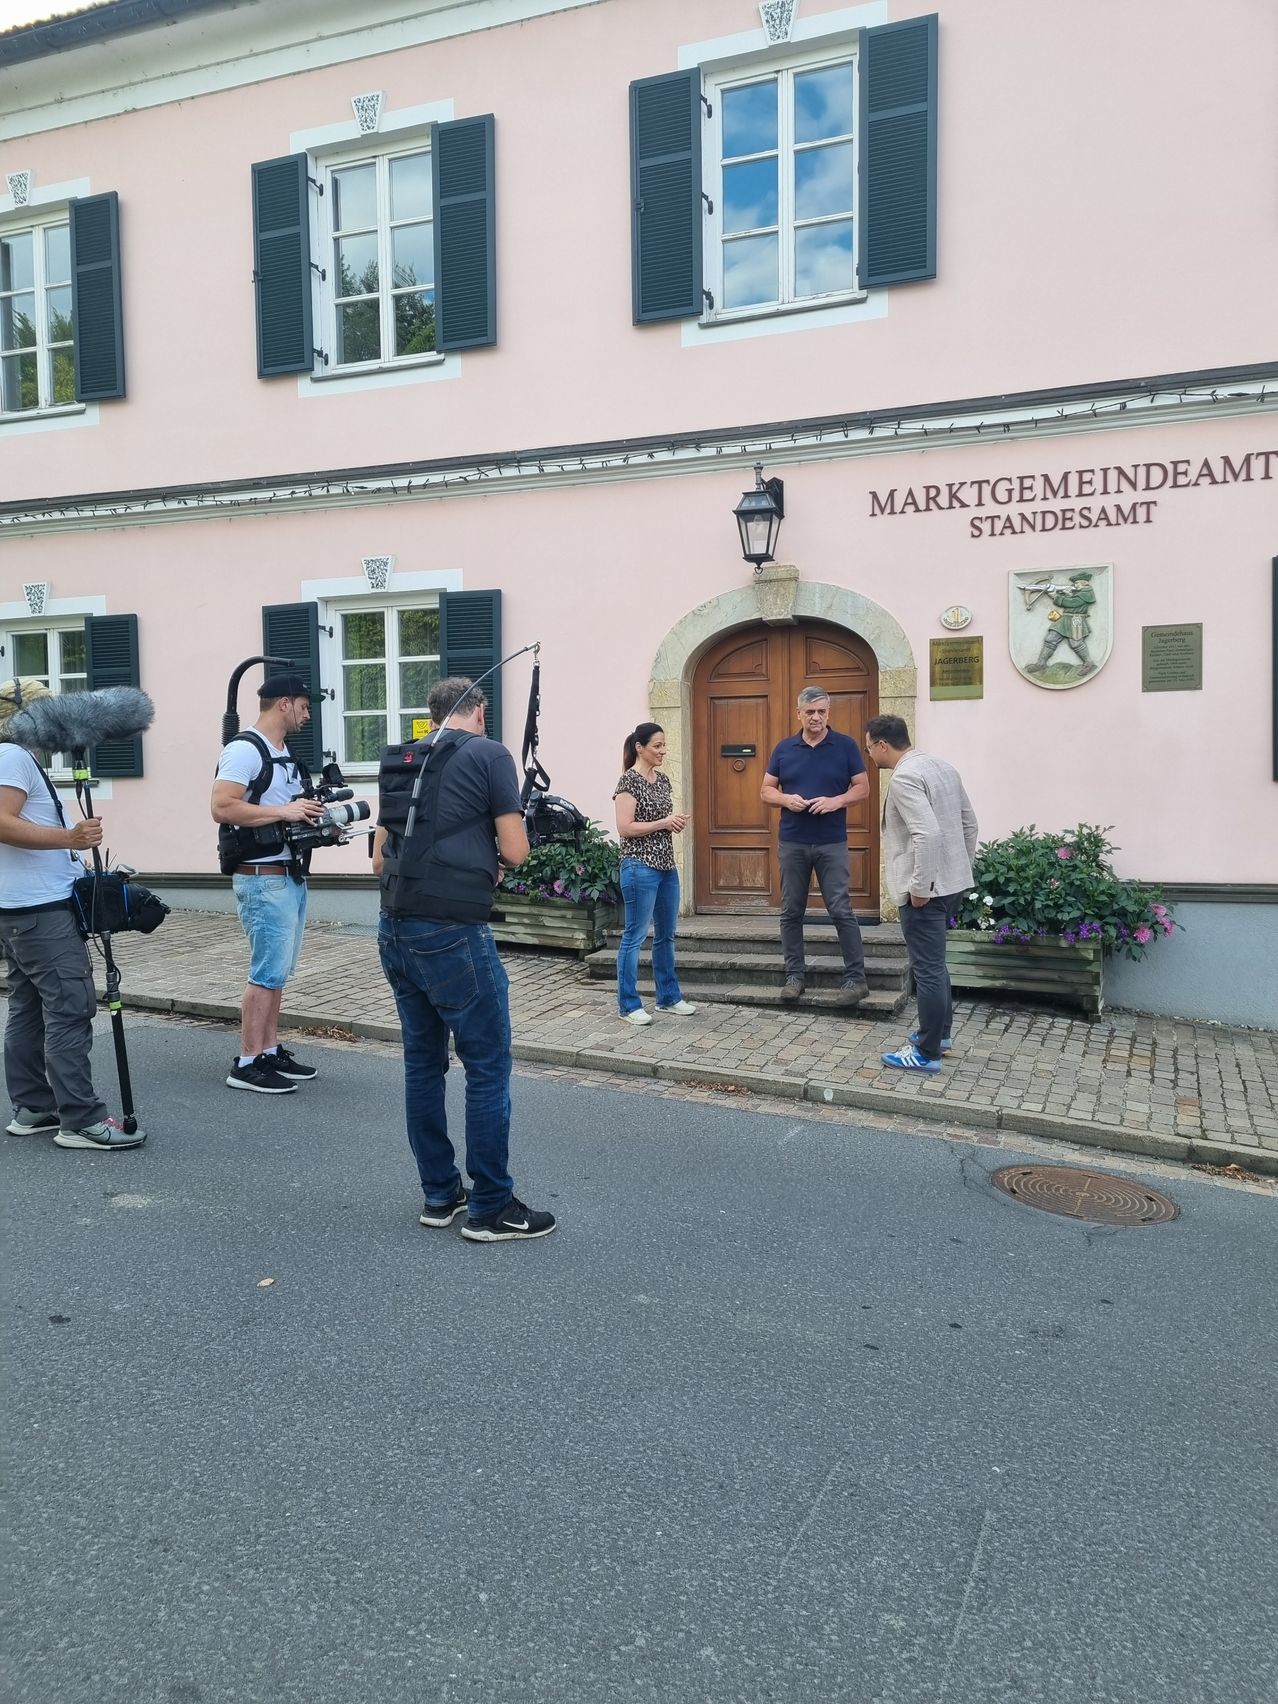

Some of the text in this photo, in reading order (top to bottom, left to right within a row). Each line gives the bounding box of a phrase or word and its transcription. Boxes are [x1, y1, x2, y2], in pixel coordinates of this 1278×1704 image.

[869, 450, 1278, 517] MARKTGEMEINDEAMT
[969, 500, 1158, 539] STANDESAMT
[952, 607, 960, 623] 1
[934, 656, 979, 665] JAGERBERG
